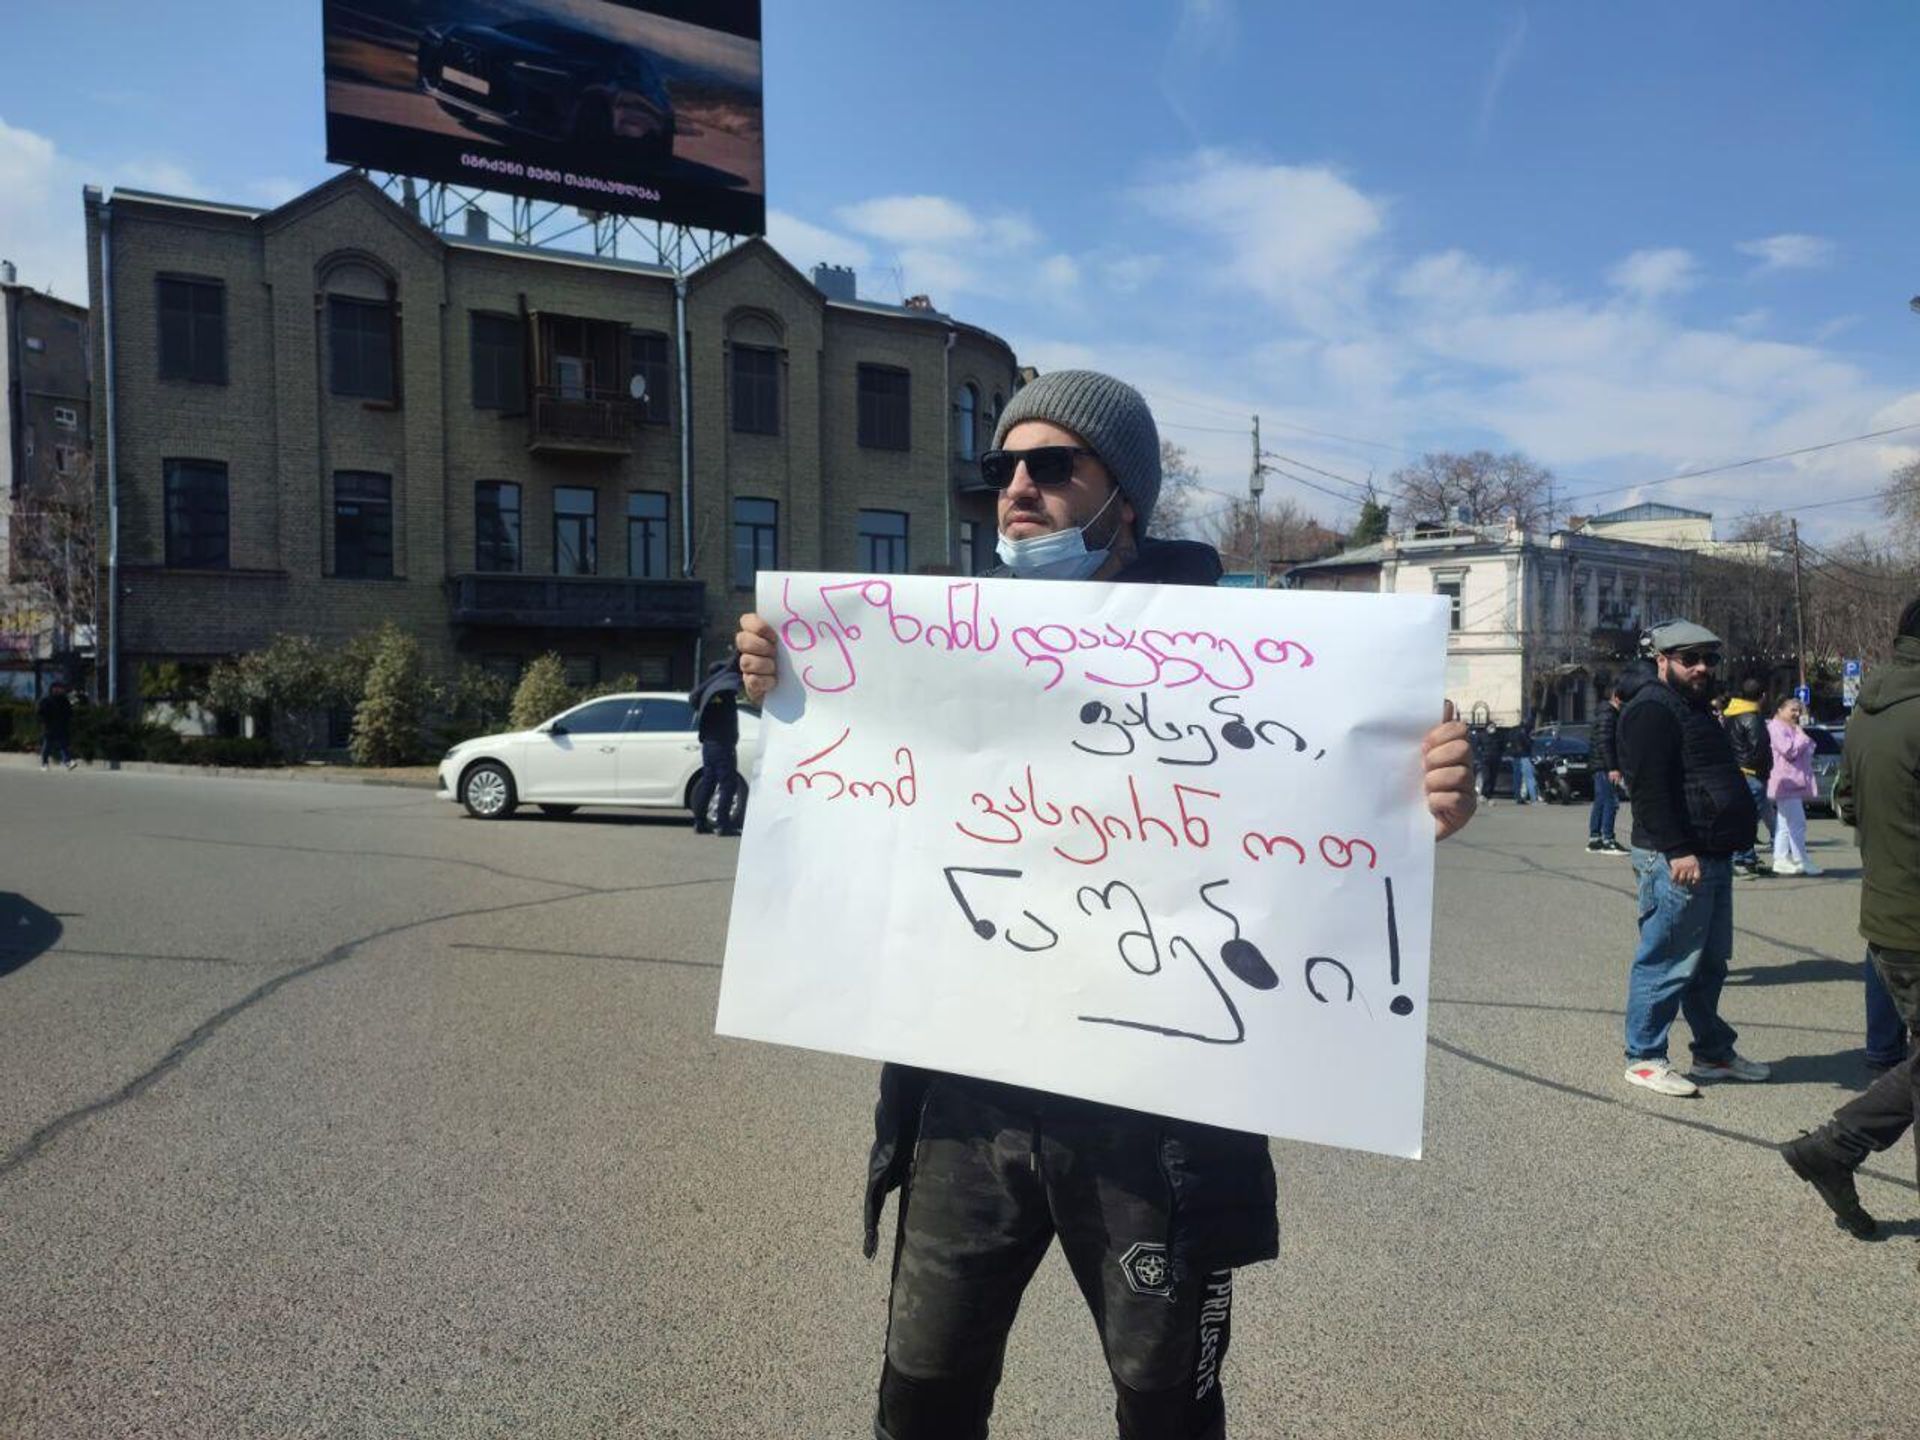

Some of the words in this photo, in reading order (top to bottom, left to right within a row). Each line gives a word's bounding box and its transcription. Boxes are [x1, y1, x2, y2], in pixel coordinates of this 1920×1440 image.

[525, 165, 562, 184] მეტი
[563, 172, 662, 201] თავისუფლება
[781, 578, 999, 692] ბენზინს
[786, 727, 917, 809] რომ
